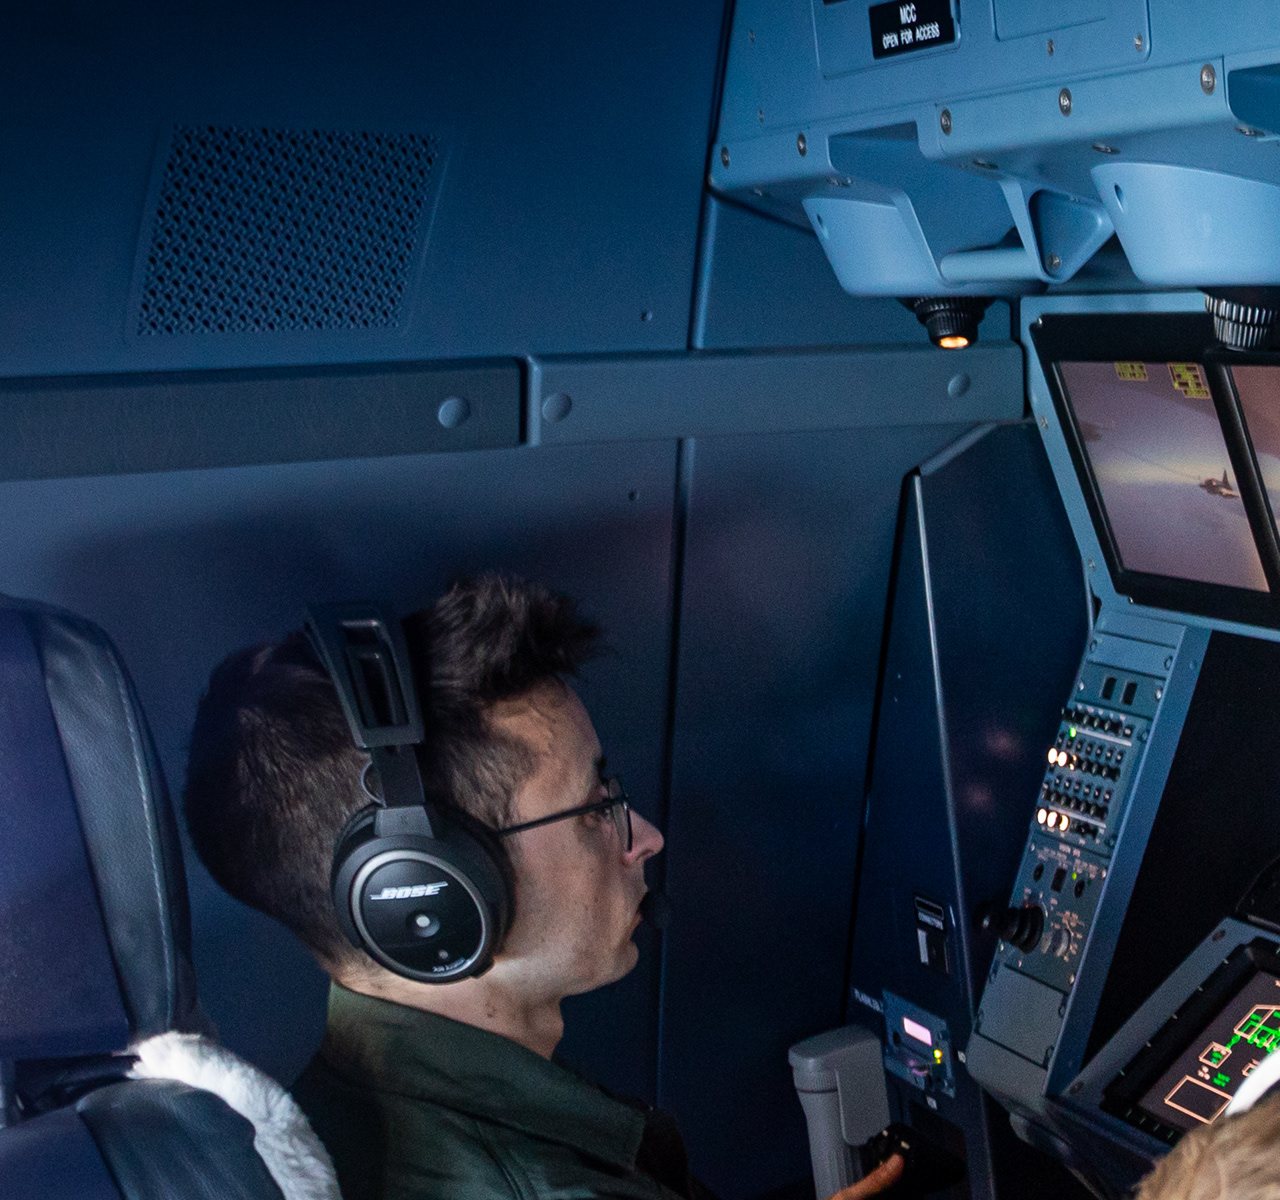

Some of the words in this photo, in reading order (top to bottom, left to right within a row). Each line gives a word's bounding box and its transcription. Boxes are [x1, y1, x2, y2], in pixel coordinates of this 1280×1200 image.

[900, 3, 917, 24] MCC
[882, 32, 899, 49] OPEN
[901, 29, 913, 45] FOR
[915, 21, 940, 42] ACCESS
[370, 881, 449, 900] BOSE
